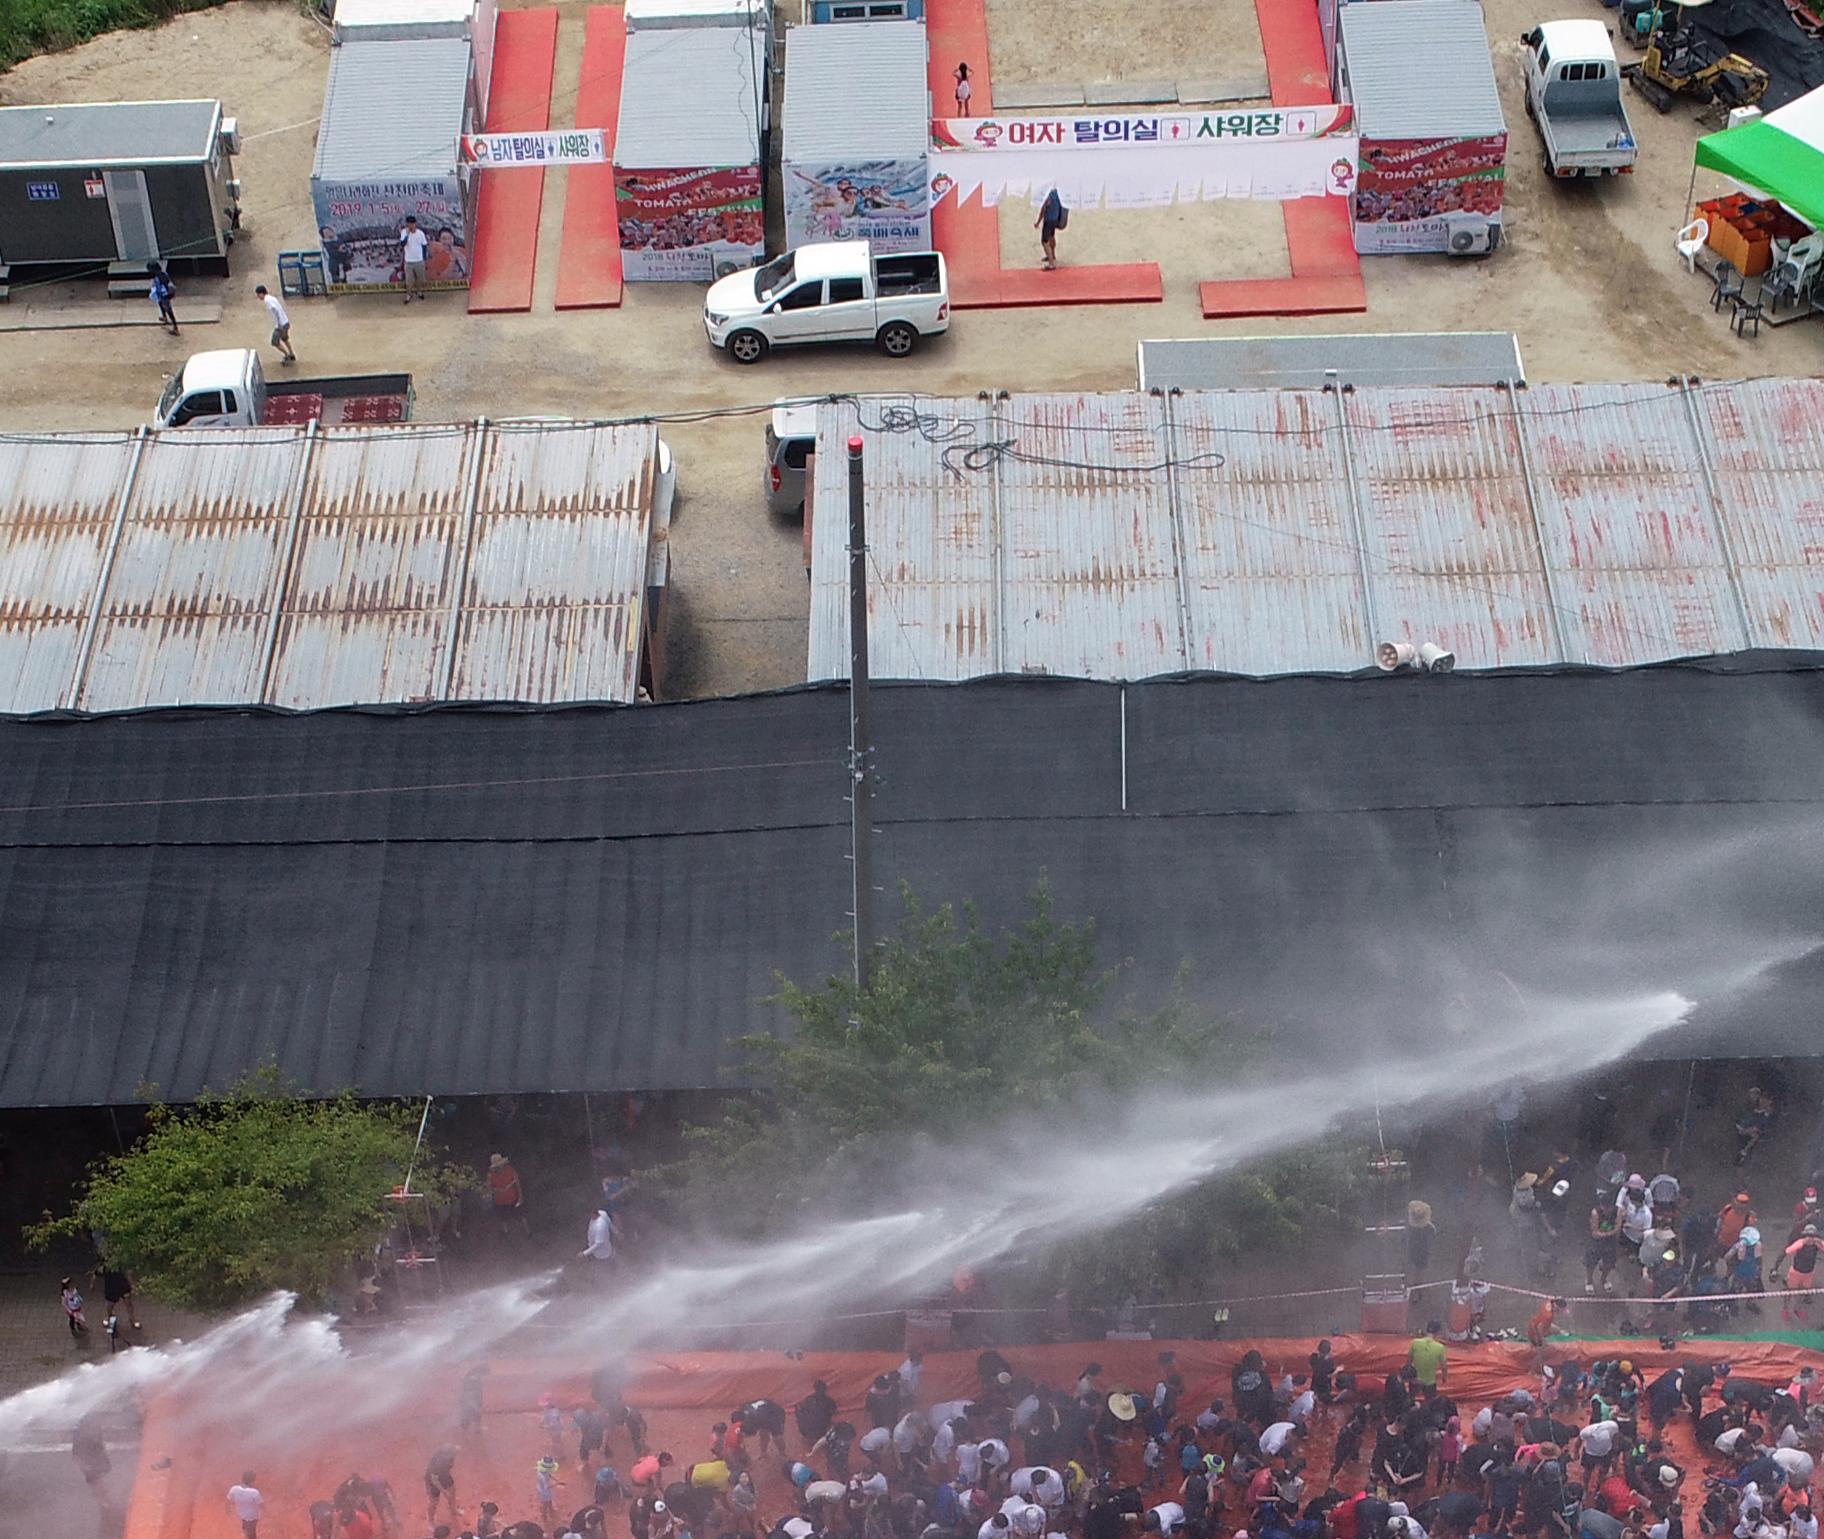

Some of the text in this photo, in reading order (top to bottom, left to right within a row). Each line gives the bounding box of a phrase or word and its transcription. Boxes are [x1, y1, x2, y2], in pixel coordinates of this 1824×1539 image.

[1009, 113, 1283, 144] 여자 탈의실 샤워장
[643, 167, 717, 192] HWACHEON
[330, 203, 362, 217] 2019
